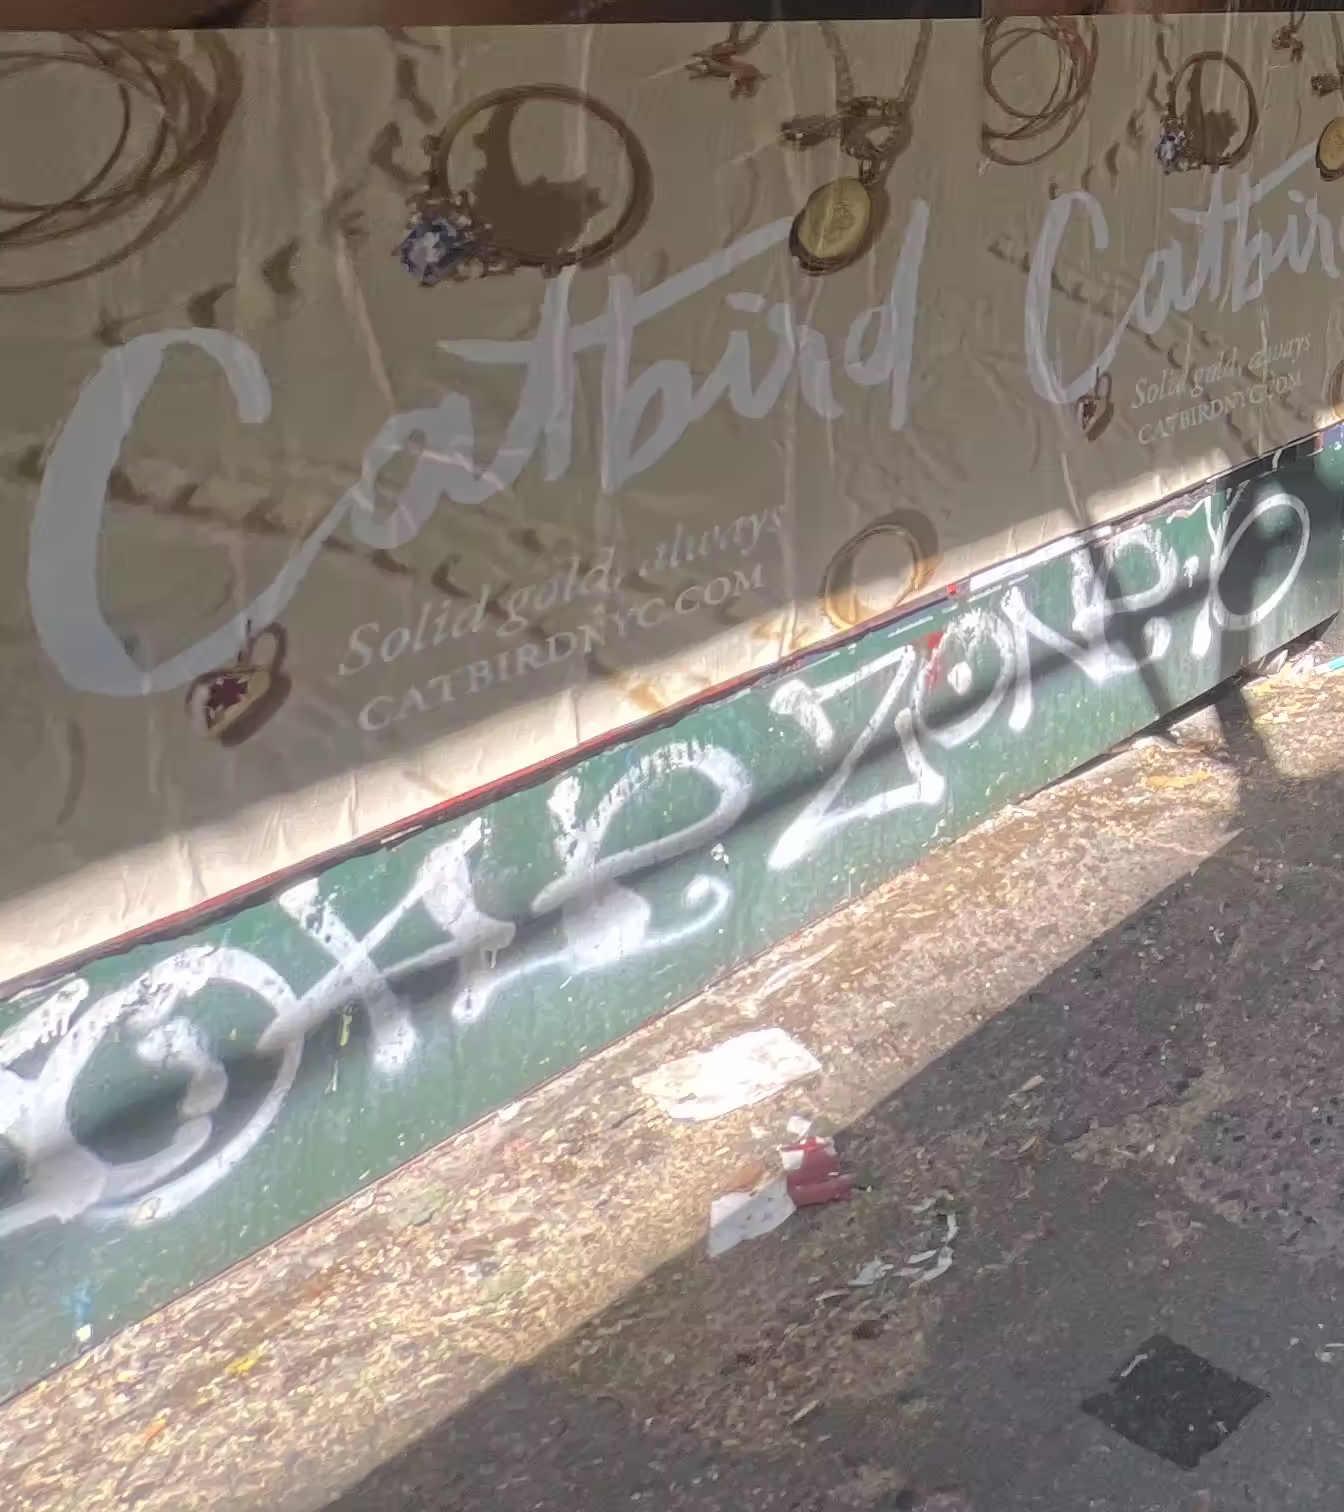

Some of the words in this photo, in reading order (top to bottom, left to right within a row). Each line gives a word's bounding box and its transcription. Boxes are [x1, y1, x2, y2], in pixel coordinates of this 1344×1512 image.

[28, 198, 930, 697] Catbird
[1131, 344, 1190, 409] Solid
[338, 583, 494, 678] Solid
[495, 546, 624, 638] gold,
[639, 502, 788, 579] always
[358, 562, 764, 732] CATBIRDNYC.COM
